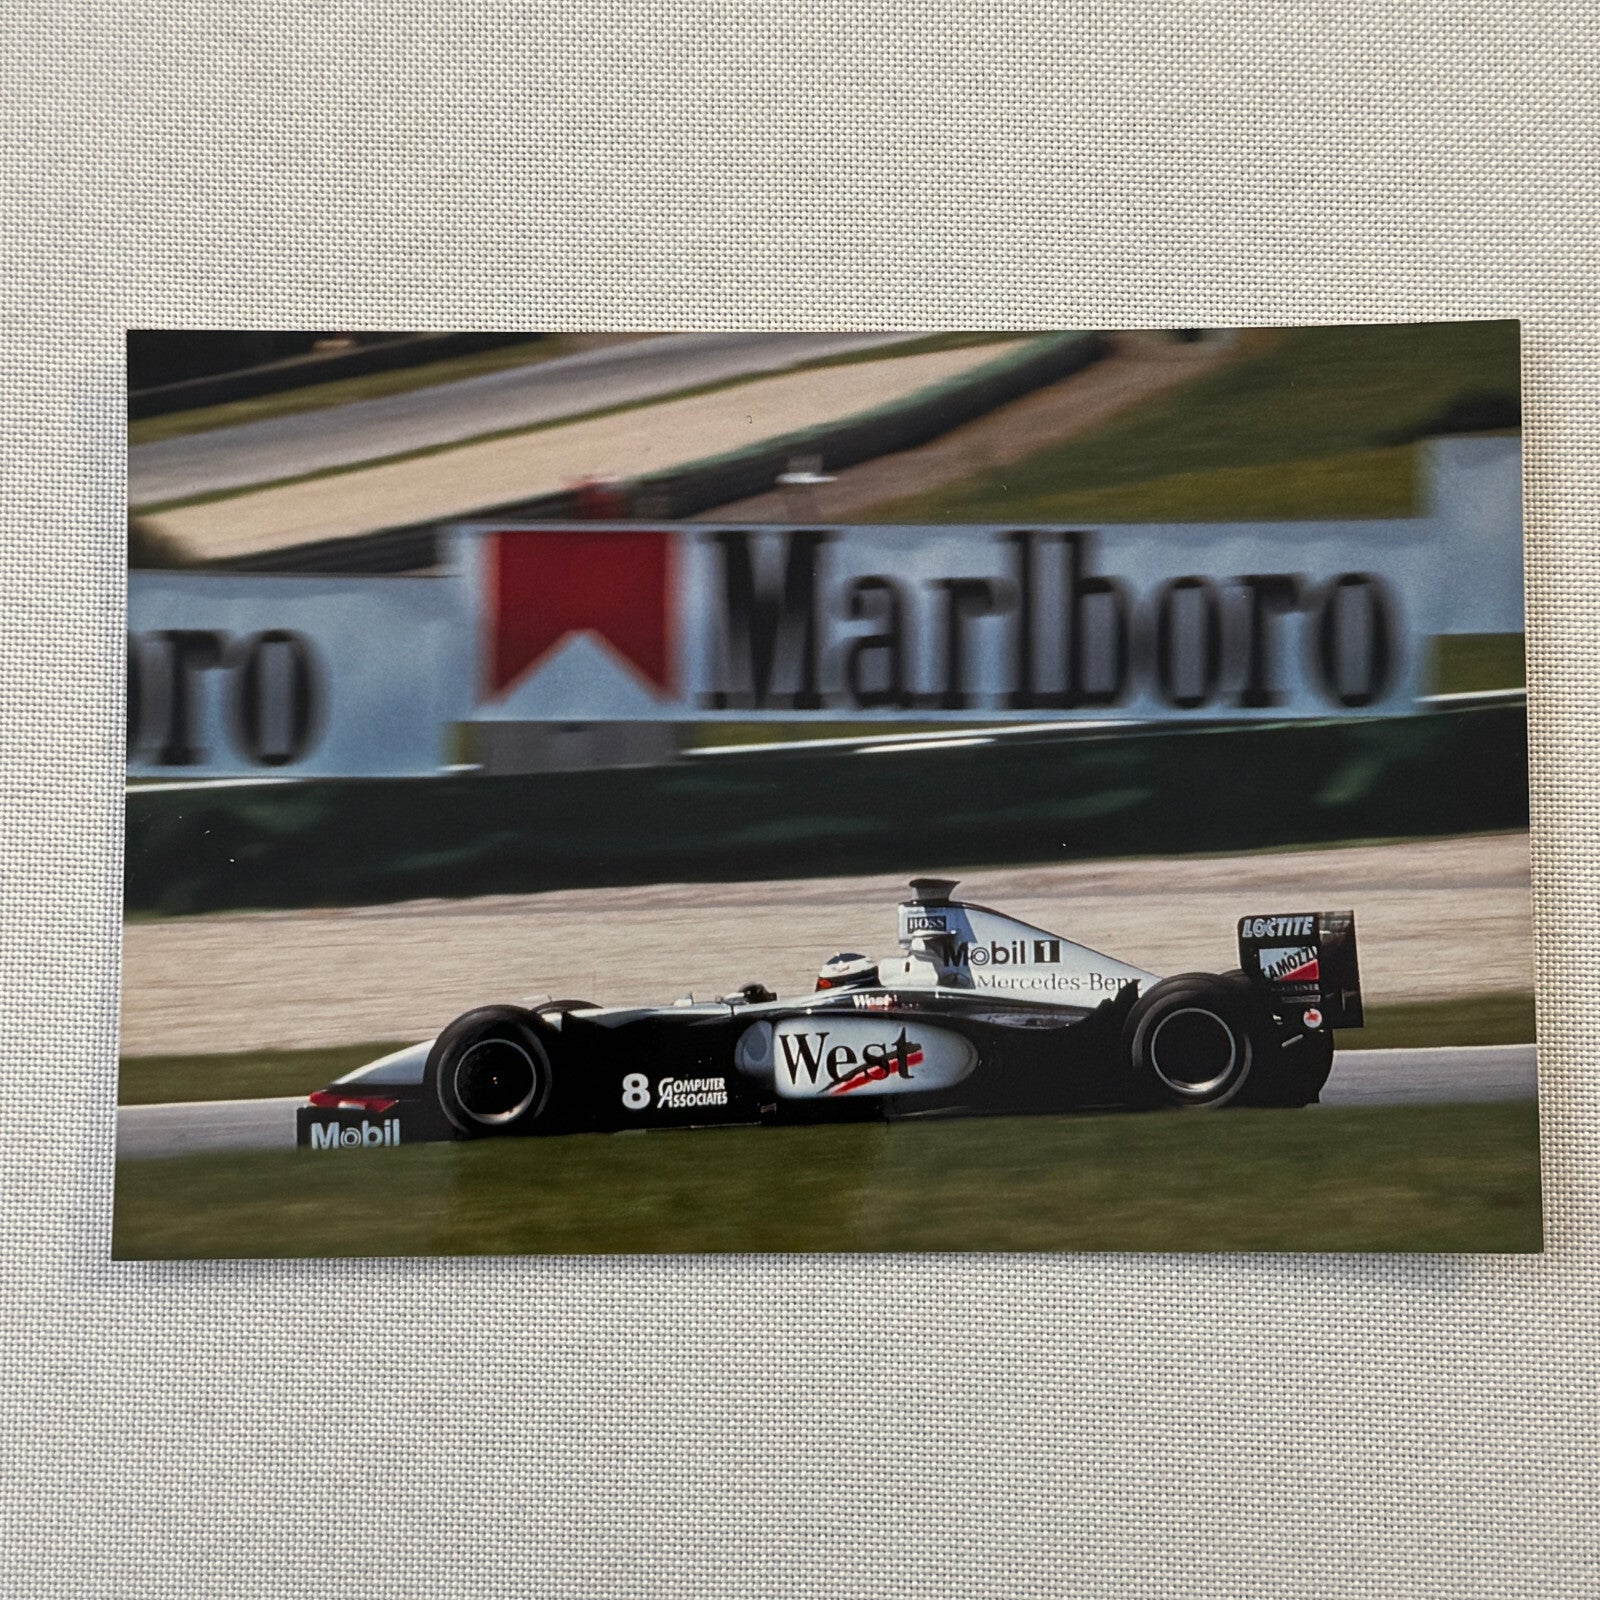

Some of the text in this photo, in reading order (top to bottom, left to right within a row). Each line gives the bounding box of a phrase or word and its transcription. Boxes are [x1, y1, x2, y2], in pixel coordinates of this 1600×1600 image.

[698, 528, 1404, 711] Marlboro
[909, 918, 945, 930] BOSS
[1242, 916, 1314, 938] LOCTITE
[943, 940, 1026, 967] Mobil
[779, 1027, 914, 1085] West
[621, 1073, 651, 1110] 8
[657, 1091, 728, 1109] ASSOCIATES
[658, 1077, 725, 1096] COMPUTER
[310, 1118, 400, 1149] Mobil
